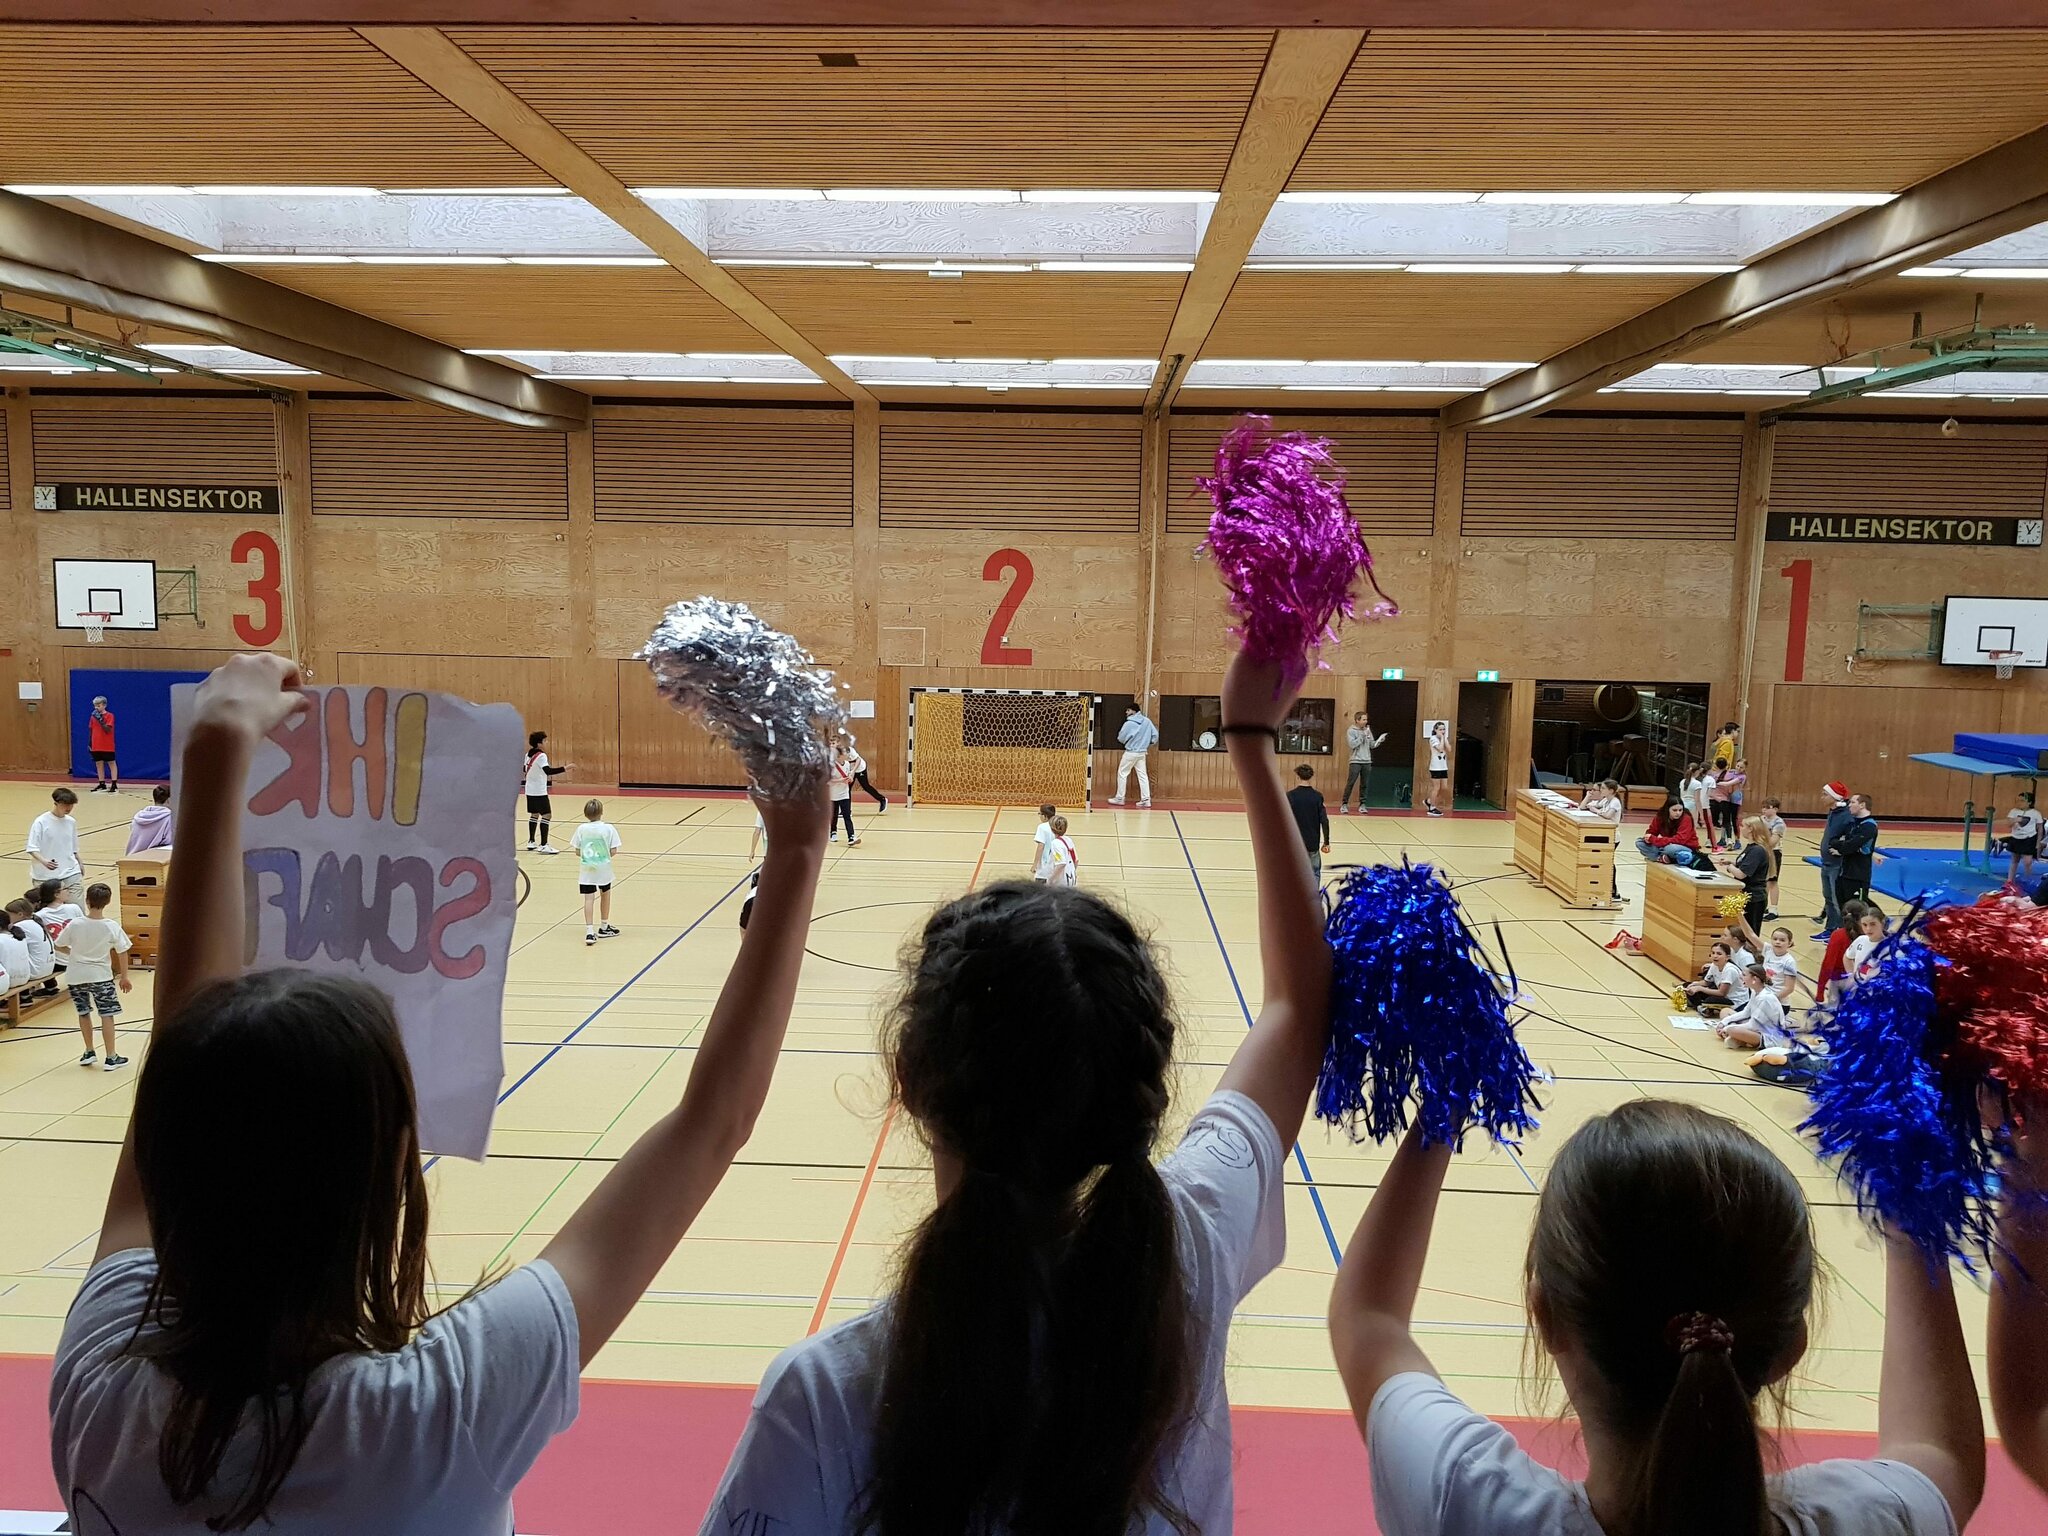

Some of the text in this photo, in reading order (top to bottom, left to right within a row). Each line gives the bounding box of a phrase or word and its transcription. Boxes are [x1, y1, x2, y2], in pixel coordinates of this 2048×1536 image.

[76, 487, 263, 510] HALLENSEKTOR
[1788, 516, 1994, 541] HALLENSEKTOR
[231, 530, 282, 646] 3
[981, 548, 1034, 665] 2
[1781, 559, 1813, 681] 1
